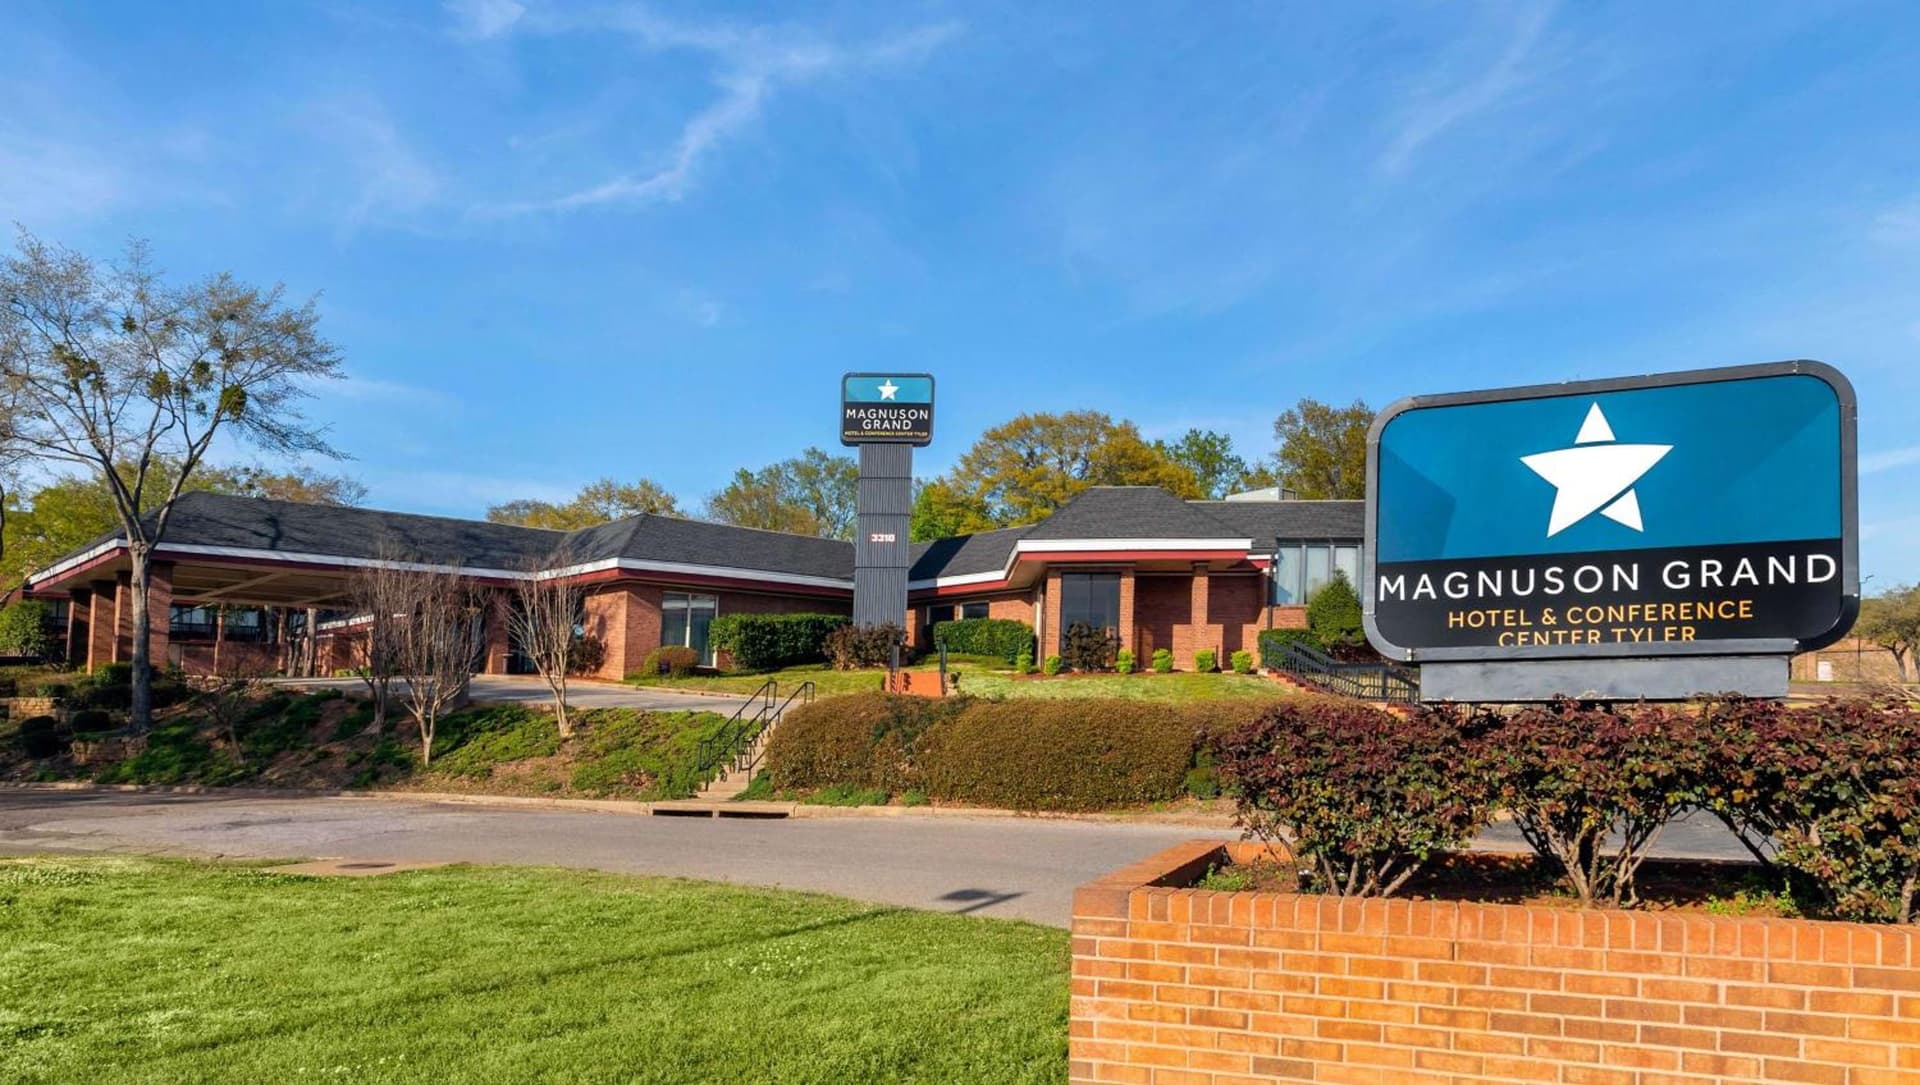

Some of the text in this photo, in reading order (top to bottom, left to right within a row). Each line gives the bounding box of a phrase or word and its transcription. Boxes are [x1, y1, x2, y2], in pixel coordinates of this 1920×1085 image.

[846, 408, 929, 420] MAGNUSON
[862, 419, 912, 430] GRAND
[1379, 554, 1837, 602] MAGNUSON GRAND
[1448, 600, 1753, 628] HOTEL & CONFERENCE
[1497, 628, 1601, 647] CENTER
